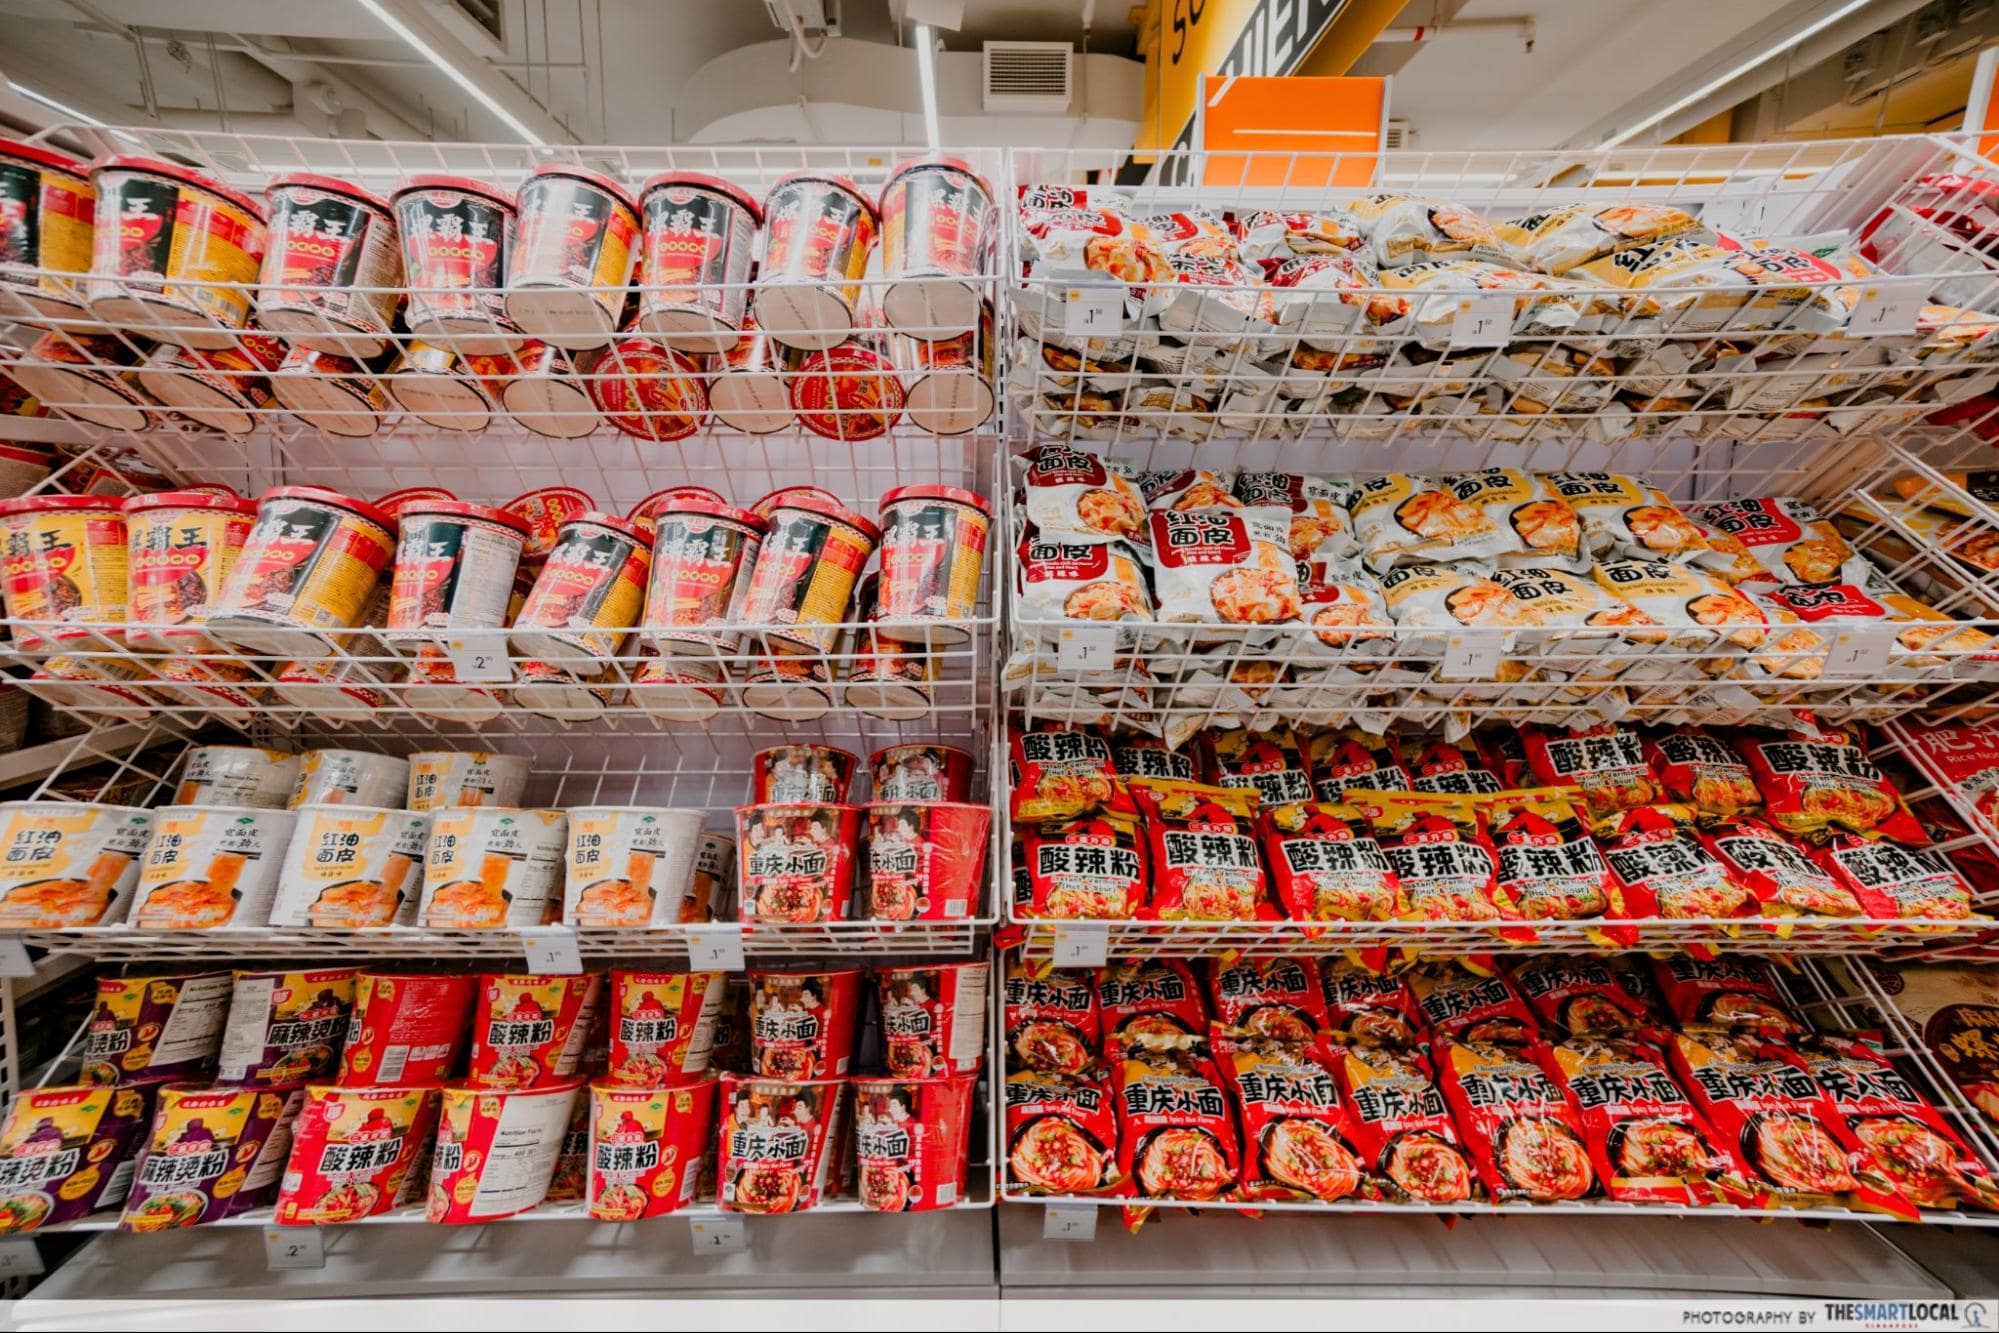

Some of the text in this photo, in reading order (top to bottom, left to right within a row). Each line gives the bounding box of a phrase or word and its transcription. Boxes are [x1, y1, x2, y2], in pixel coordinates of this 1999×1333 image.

[1169, 527, 1235, 547] 面皮
[1511, 580, 1574, 600] 面皮
[1024, 733, 1111, 762] 酸辣粉
[1548, 734, 1644, 774] 酸辣粉
[1762, 743, 1882, 782] 酸辣粉
[1116, 750, 1192, 779] 酸辣粉
[320, 832, 361, 847] 红油
[1165, 833, 1259, 868] 酸辣粉
[316, 848, 356, 864] 面皮
[749, 850, 826, 877] 重庆小面
[1039, 846, 1140, 881] 酸辣粉
[1283, 839, 1391, 873] 酸辣粉
[1384, 844, 1494, 880] 酸辣粉
[1498, 837, 1606, 884] 酸辣粉
[1006, 979, 1091, 1011] 重庆小面
[1100, 975, 1186, 1008] 重庆小面
[1220, 966, 1308, 998] 重庆小面
[1519, 967, 1611, 998] 重庆小面
[1422, 980, 1511, 1025] 重庆小面
[489, 1022, 553, 1046] 酸辣粉
[620, 1019, 677, 1043] 酸辣粉
[755, 1014, 817, 1041] 重庆小面
[1007, 1083, 1100, 1112] 重庆小面
[1124, 1082, 1224, 1117] 重庆小面
[1237, 1072, 1339, 1108] 重庆小面
[1461, 1074, 1567, 1108] 重庆小面
[1570, 1072, 1687, 1110] 重庆小面
[1694, 1065, 1822, 1104] 重庆小面
[1354, 1085, 1446, 1123] 重庆小面
[319, 1137, 403, 1173] 酸辣粉
[597, 1143, 658, 1171] 酸辣粉
[731, 1131, 808, 1161] 重庆小面
